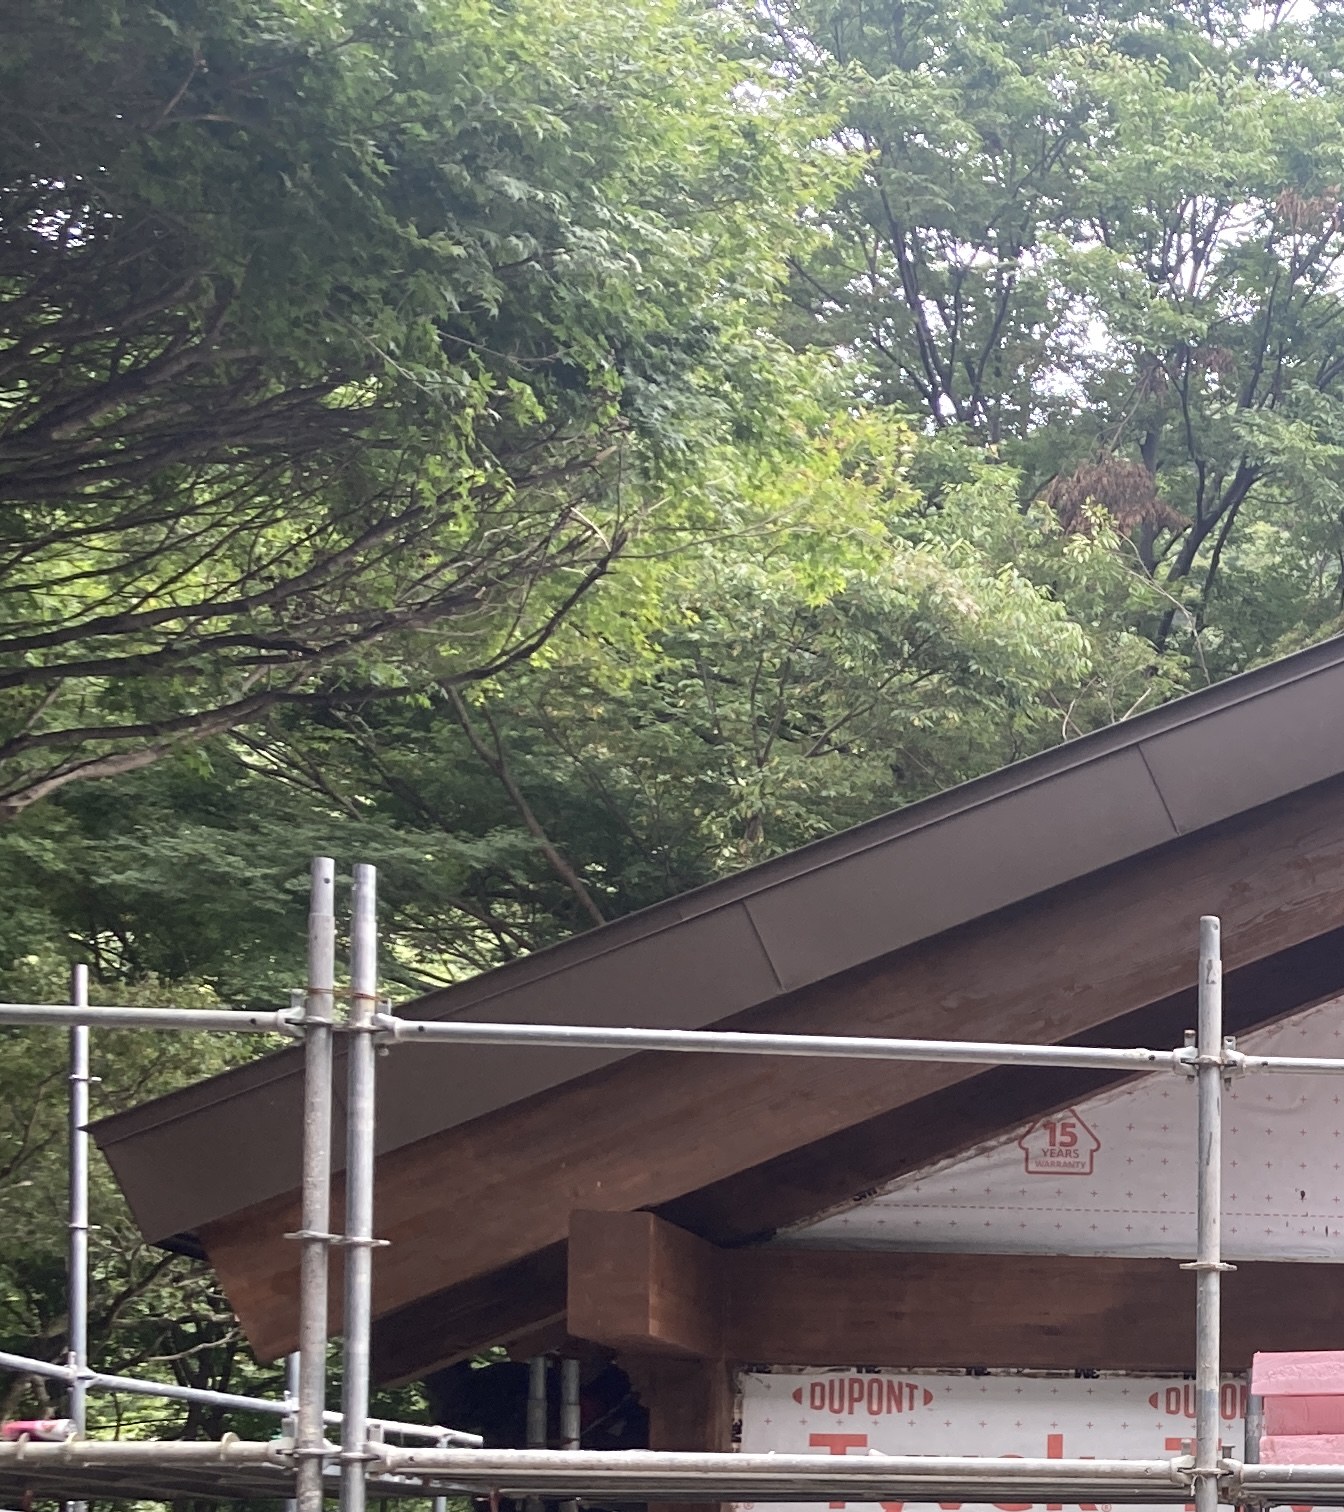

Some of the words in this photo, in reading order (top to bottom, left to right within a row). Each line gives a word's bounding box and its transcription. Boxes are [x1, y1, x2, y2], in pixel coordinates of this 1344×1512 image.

[1044, 1123, 1077, 1147] 15
[1041, 1148, 1079, 1159] YEARS
[809, 1378, 918, 1415] DUPONT
